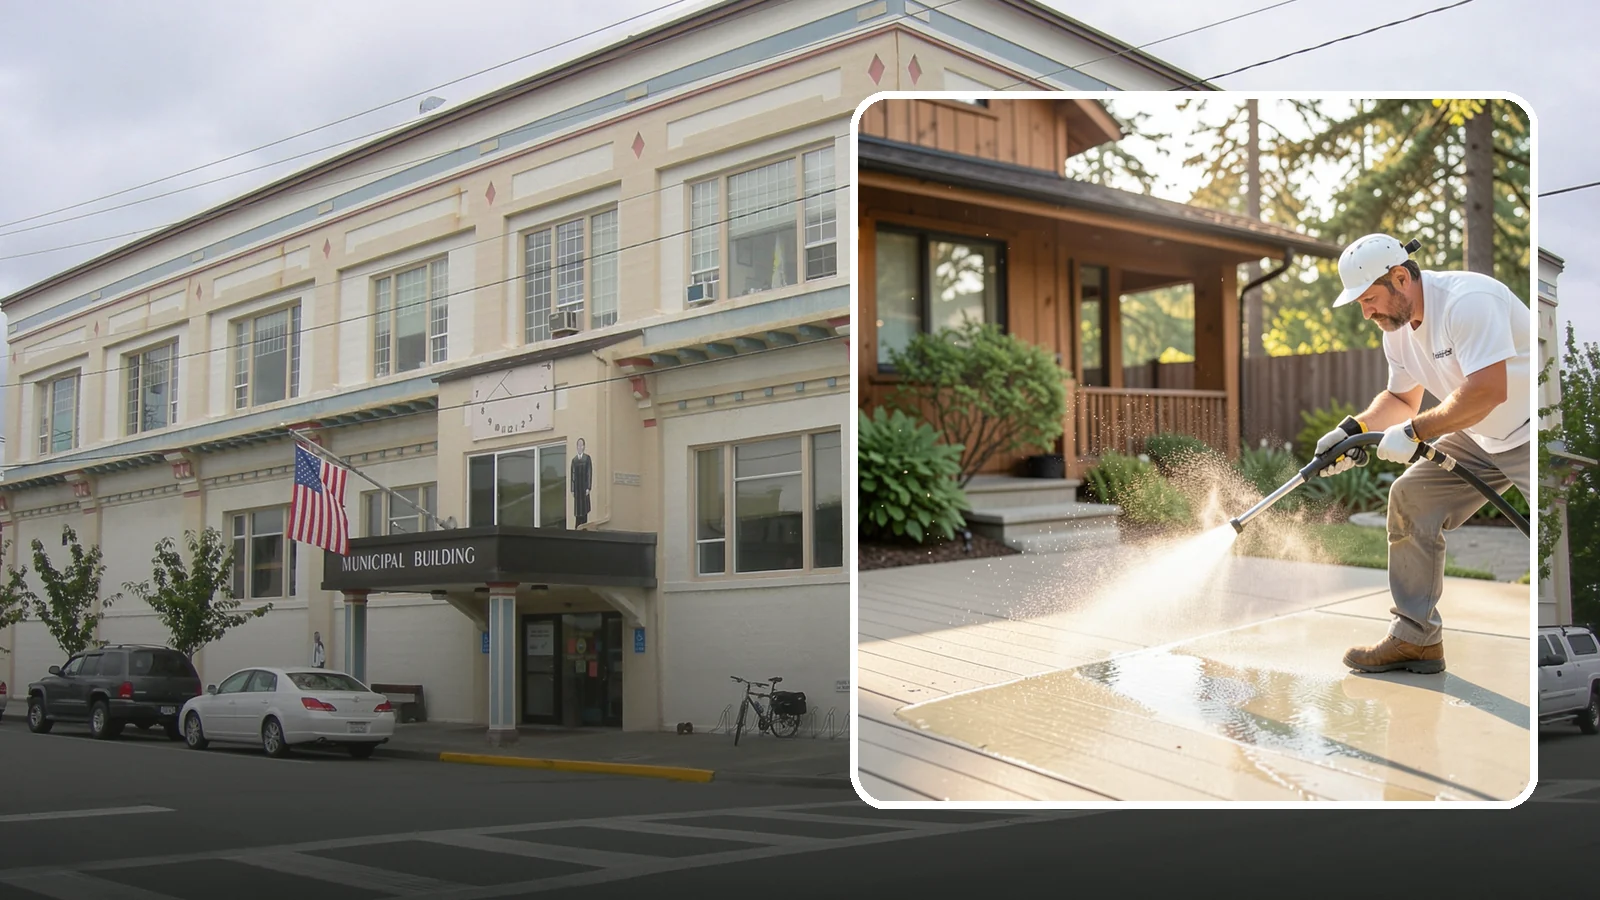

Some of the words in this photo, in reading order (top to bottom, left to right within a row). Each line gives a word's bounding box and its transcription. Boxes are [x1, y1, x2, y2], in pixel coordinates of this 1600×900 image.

[508, 425, 513, 433] 12
[342, 552, 405, 572] MUNICIPAL
[414, 546, 475, 567] BUILDING
